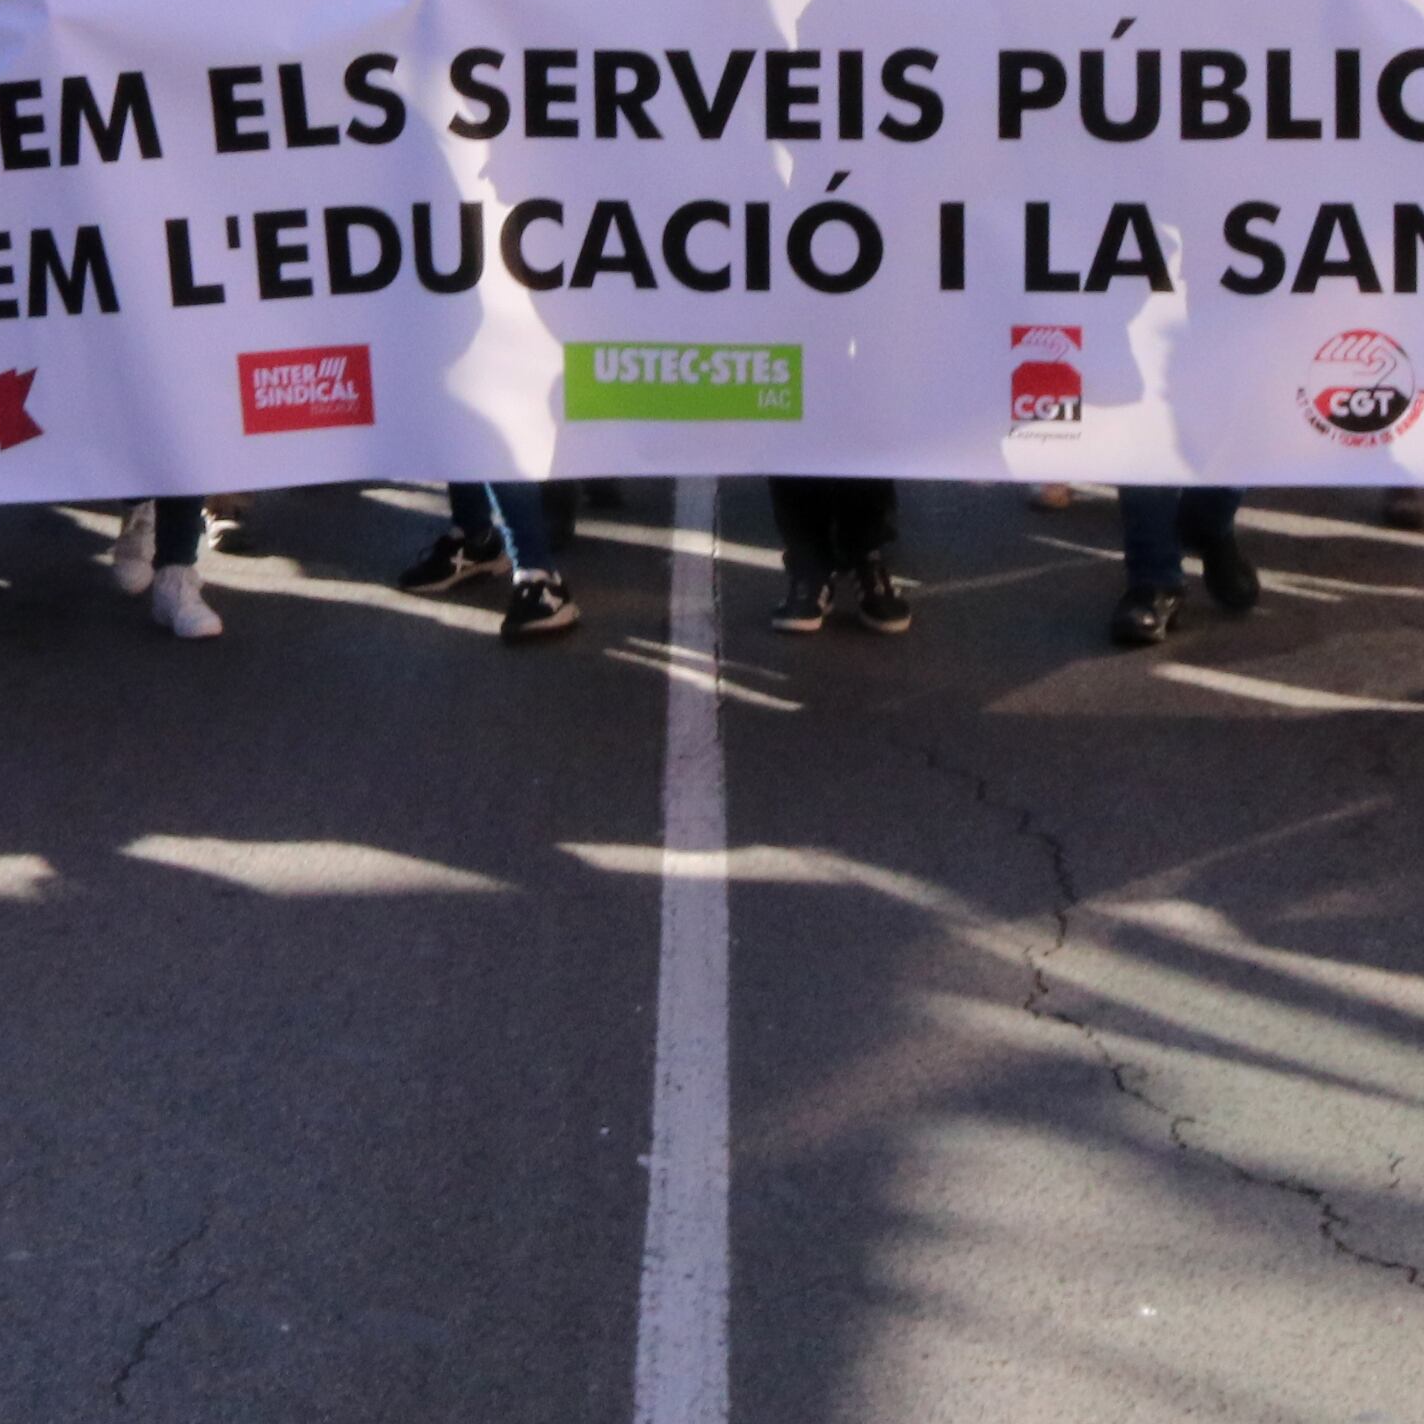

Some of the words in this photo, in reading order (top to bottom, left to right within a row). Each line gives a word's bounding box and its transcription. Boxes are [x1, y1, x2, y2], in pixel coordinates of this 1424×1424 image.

[208, 52, 407, 155] ELS
[448, 47, 945, 144] SERVEIS
[164, 170, 885, 308] L'EDUCACIÓ
[938, 201, 966, 292] I
[1023, 202, 1174, 294] LA
[254, 379, 360, 410] SINDICAL
[1014, 393, 1080, 421] CGT
[1329, 390, 1398, 417] CGT
